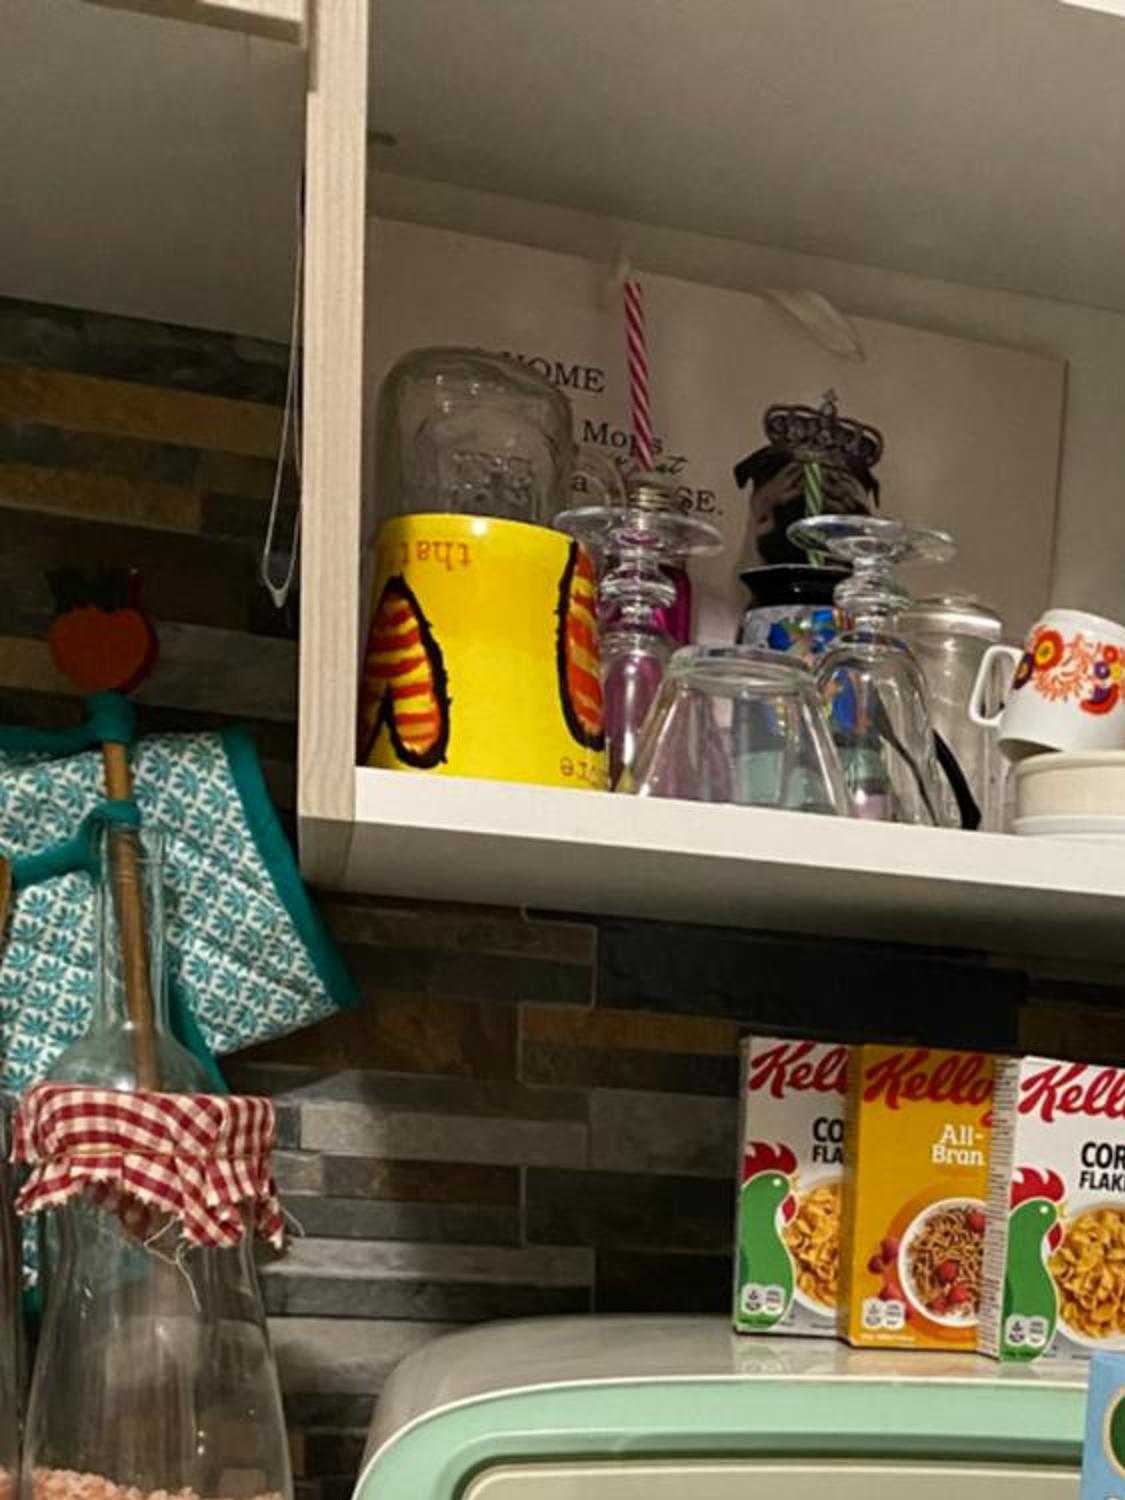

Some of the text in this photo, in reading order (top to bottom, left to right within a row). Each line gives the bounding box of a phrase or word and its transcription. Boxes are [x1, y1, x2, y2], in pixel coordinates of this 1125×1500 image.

[502, 351, 605, 393] OME
[863, 1050, 992, 1128] Kello
[941, 1124, 984, 1146] All-
[932, 1145, 985, 1167] Bran
